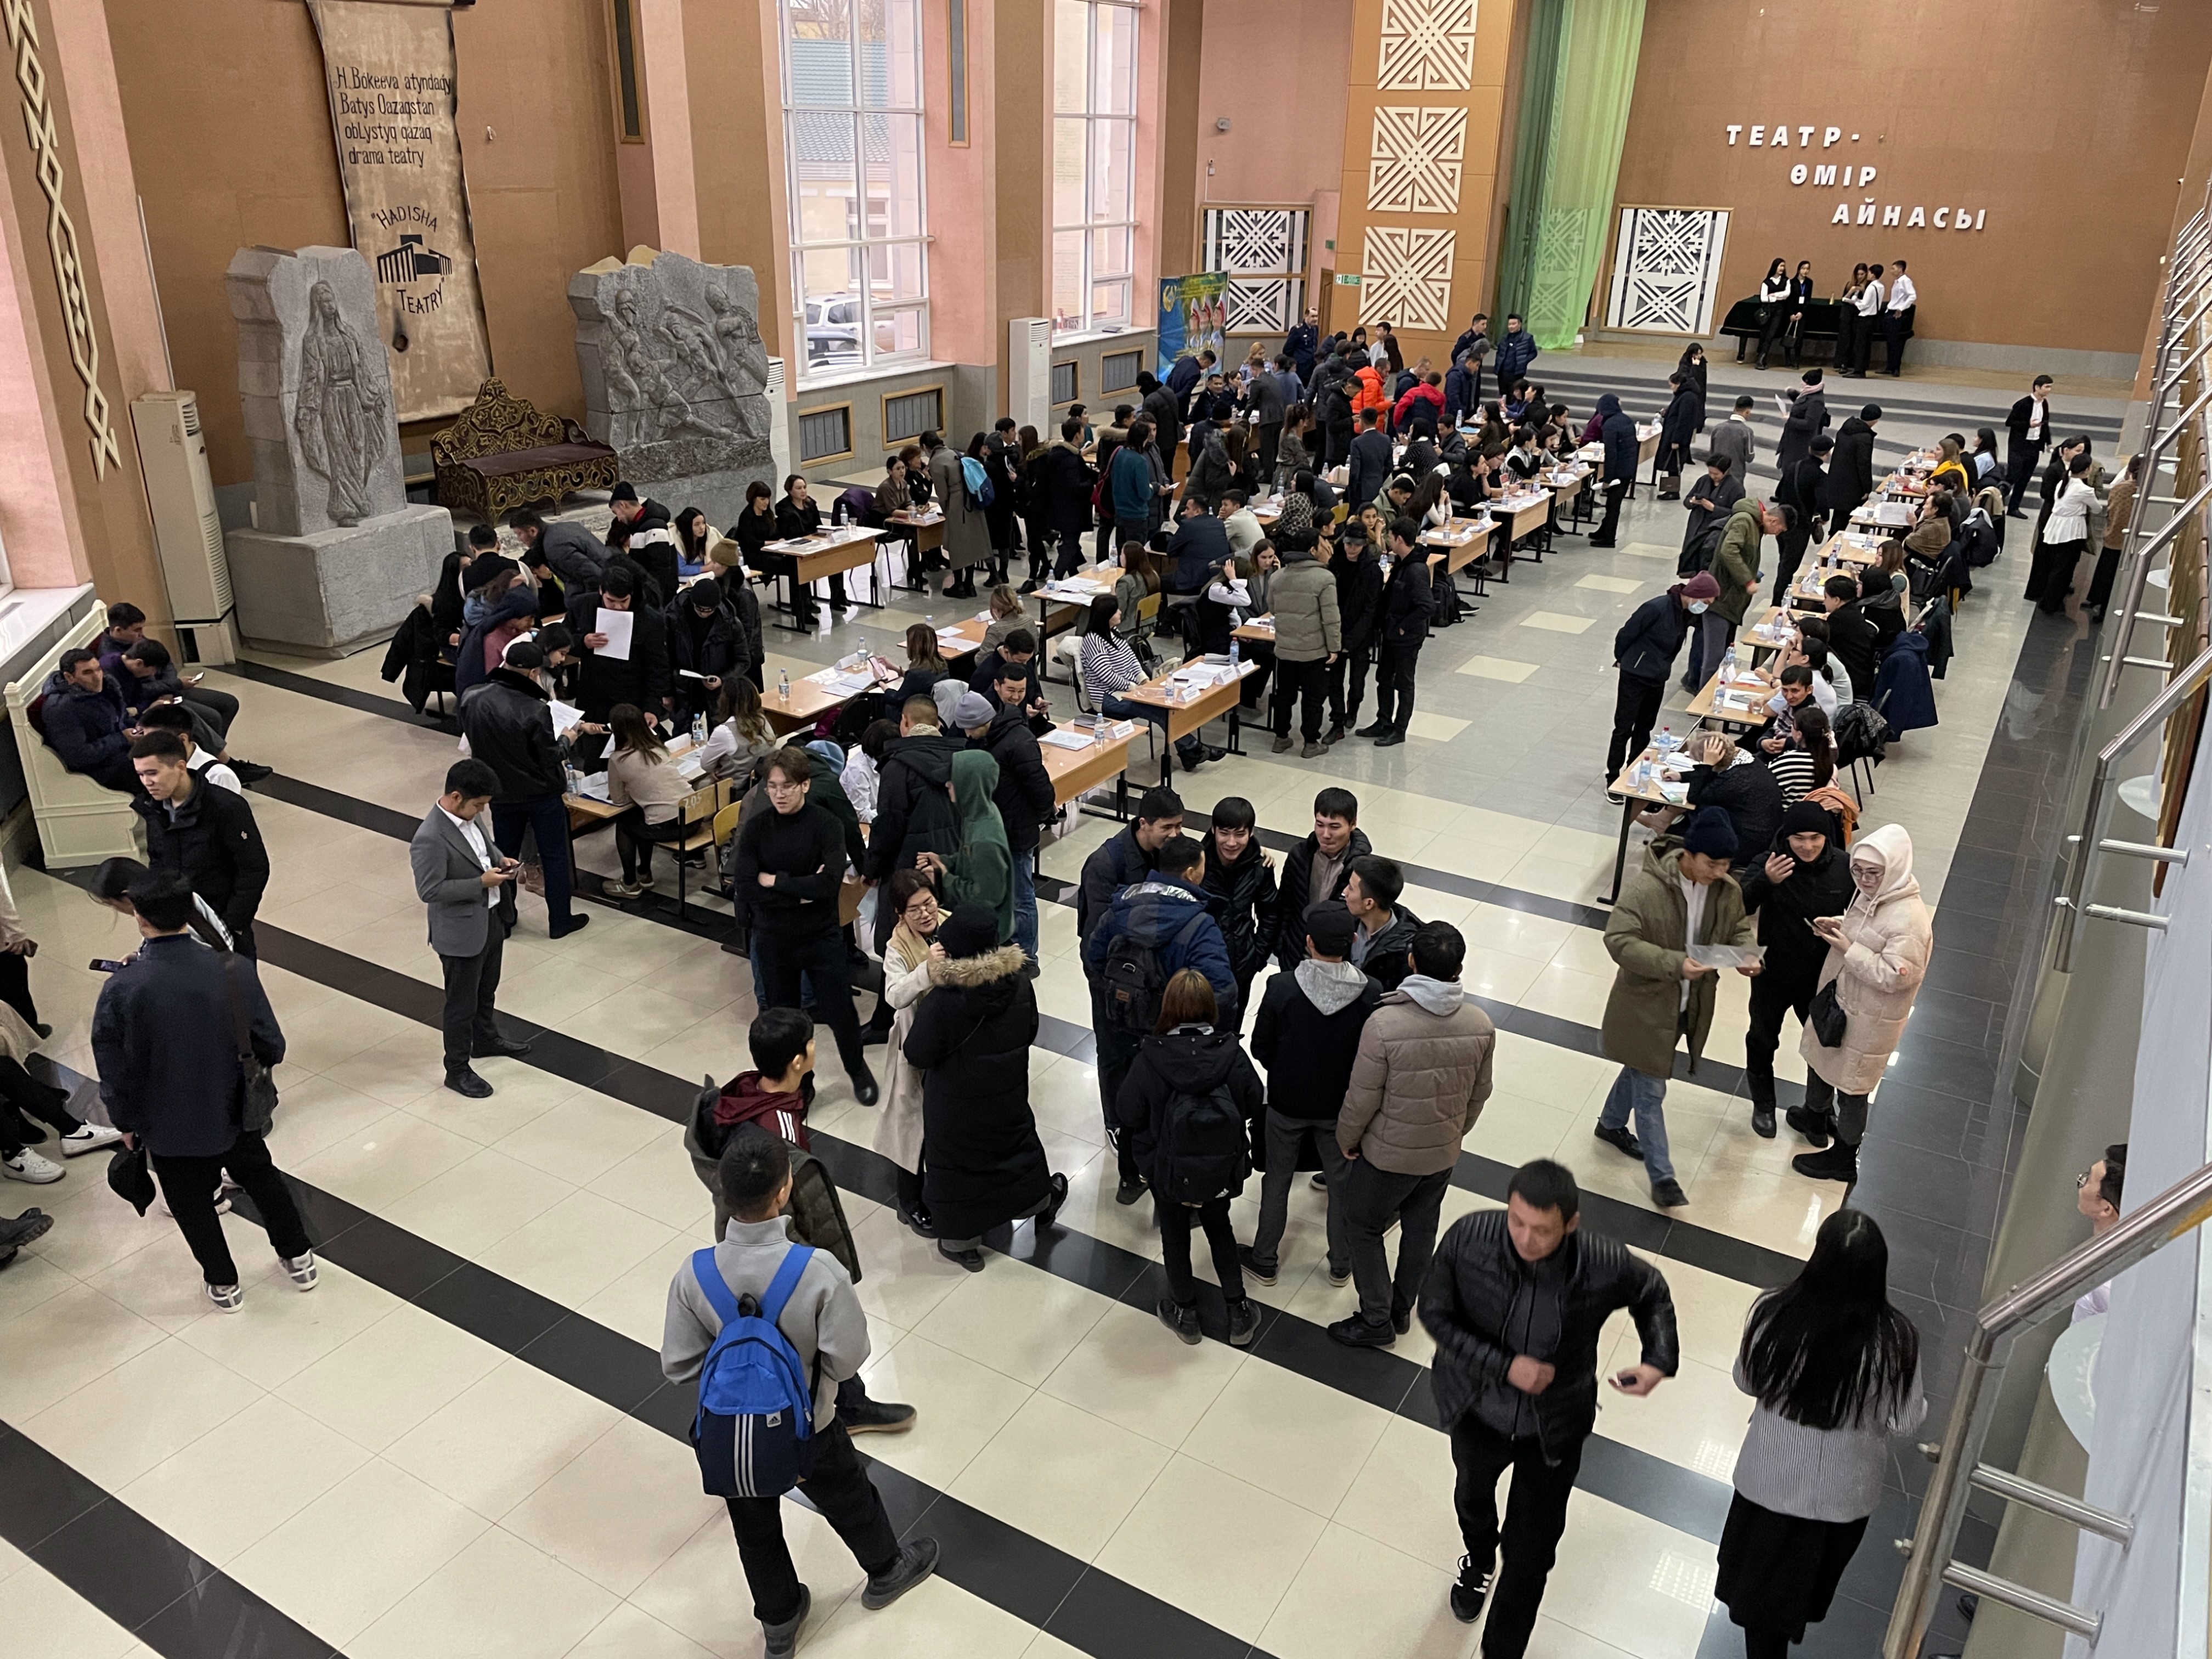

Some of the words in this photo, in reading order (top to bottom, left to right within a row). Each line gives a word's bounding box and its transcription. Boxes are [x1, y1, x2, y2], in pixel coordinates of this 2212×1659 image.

[339, 92, 375, 119] Batys
[377, 93, 435, 121] Qazaqstan
[401, 126, 433, 144] qazaq
[349, 146, 385, 165] drama
[387, 147, 424, 168] teatry
[1790, 164, 1877, 187] ӨМІР
[1831, 198, 1987, 230] АЙНАСЫ
